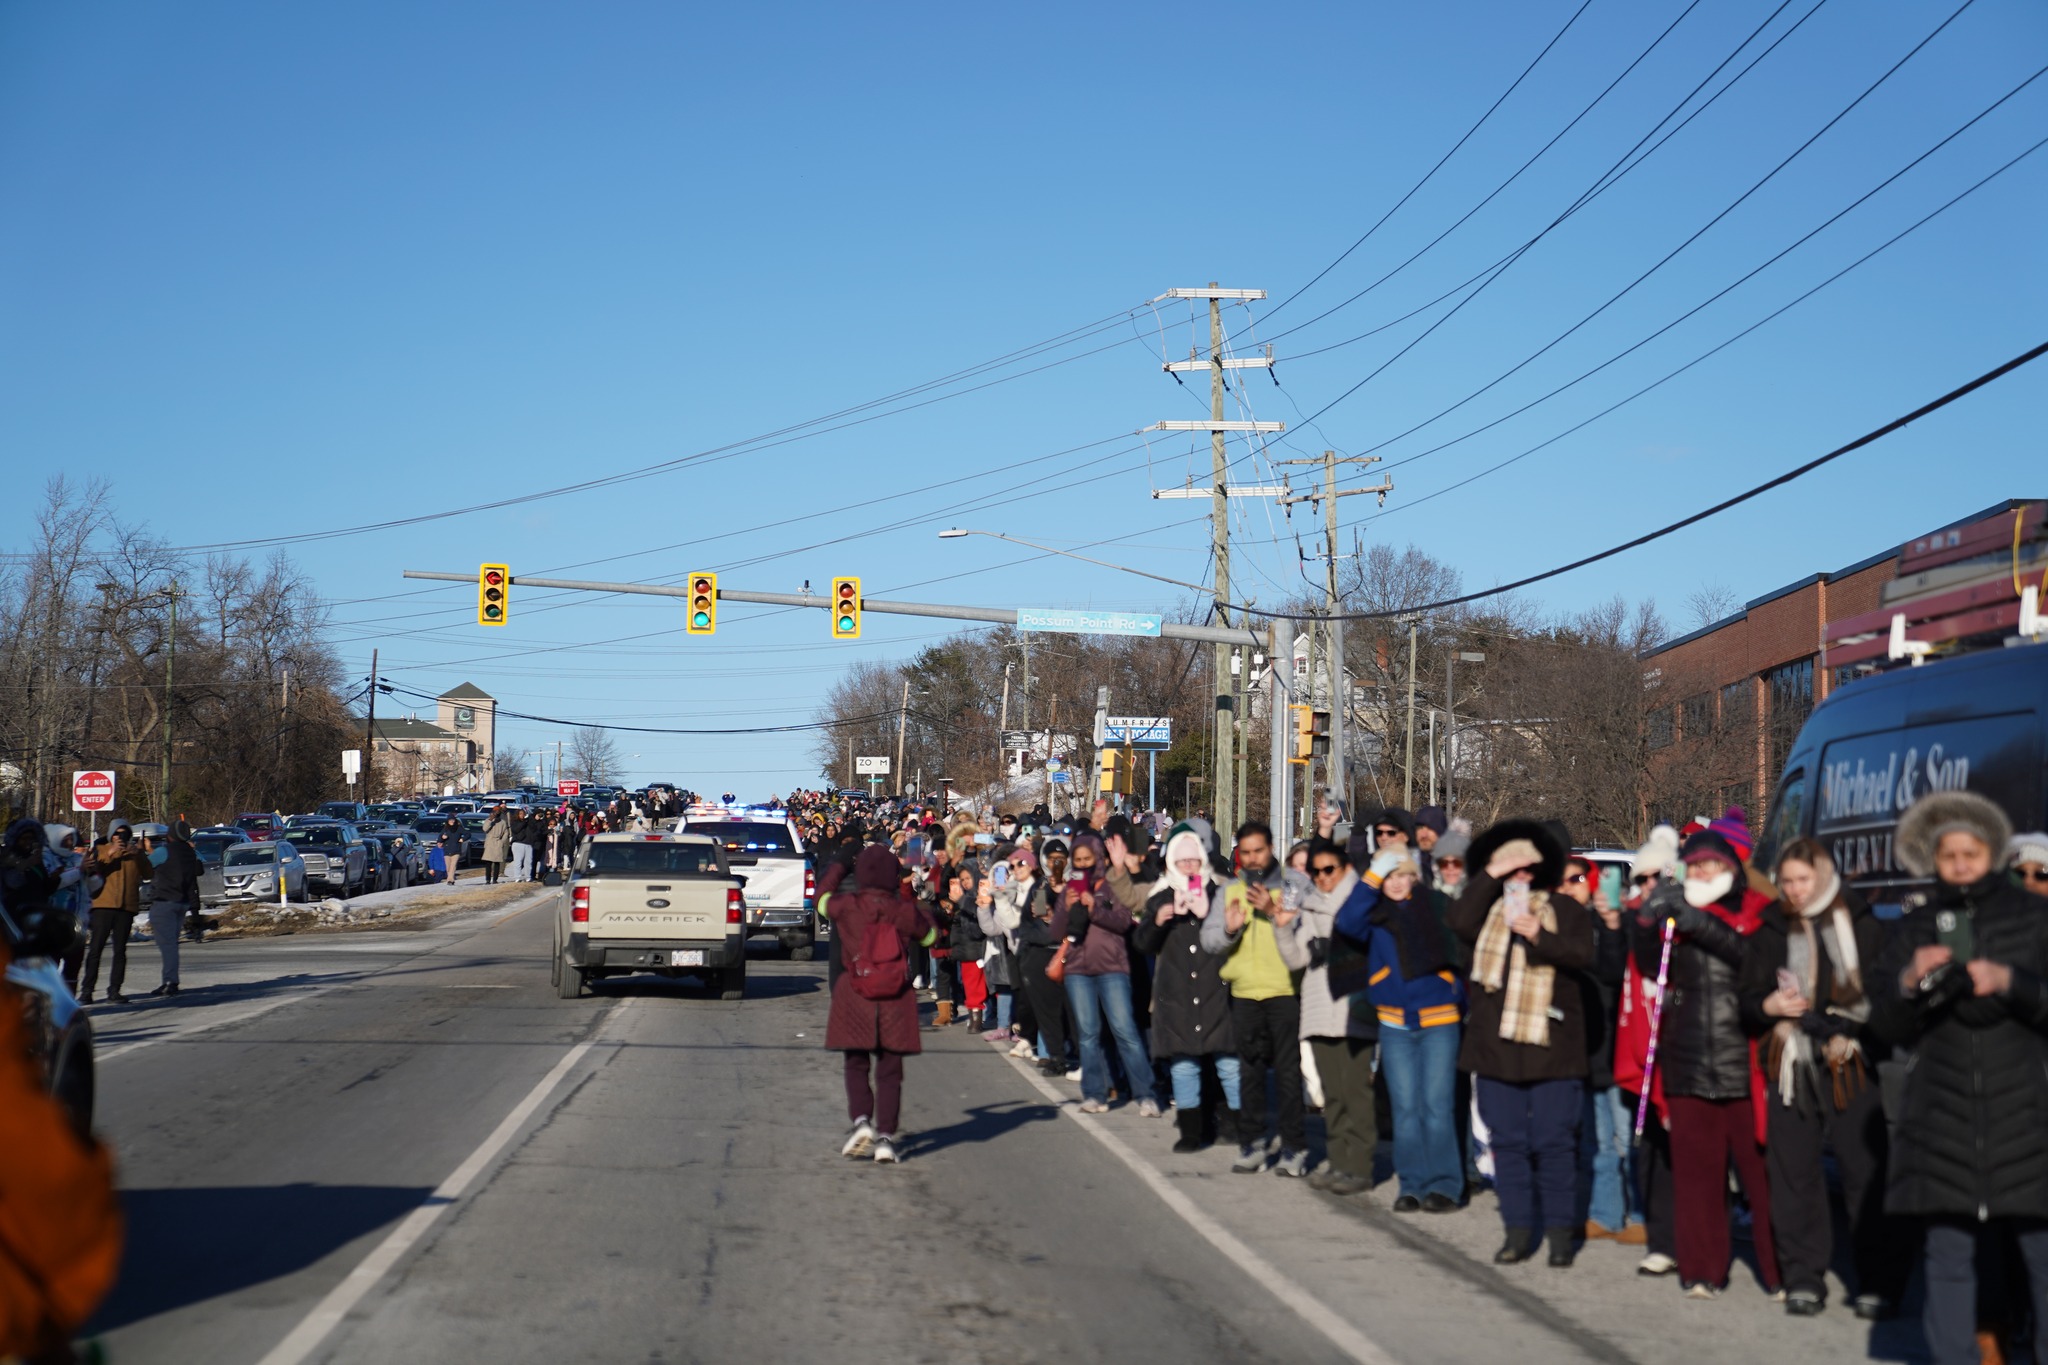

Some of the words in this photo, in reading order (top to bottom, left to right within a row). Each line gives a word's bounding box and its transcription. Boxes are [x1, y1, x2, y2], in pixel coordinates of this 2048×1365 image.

[1022, 614, 1074, 627] Possum
[1080, 616, 1113, 628] Point
[1120, 619, 1136, 630] Rd
[1130, 729, 1168, 740] TORAGE
[1820, 752, 1897, 821] Michael
[1895, 747, 1920, 811] &
[1926, 742, 1970, 792] Son
[608, 915, 706, 923] MAVERICK
